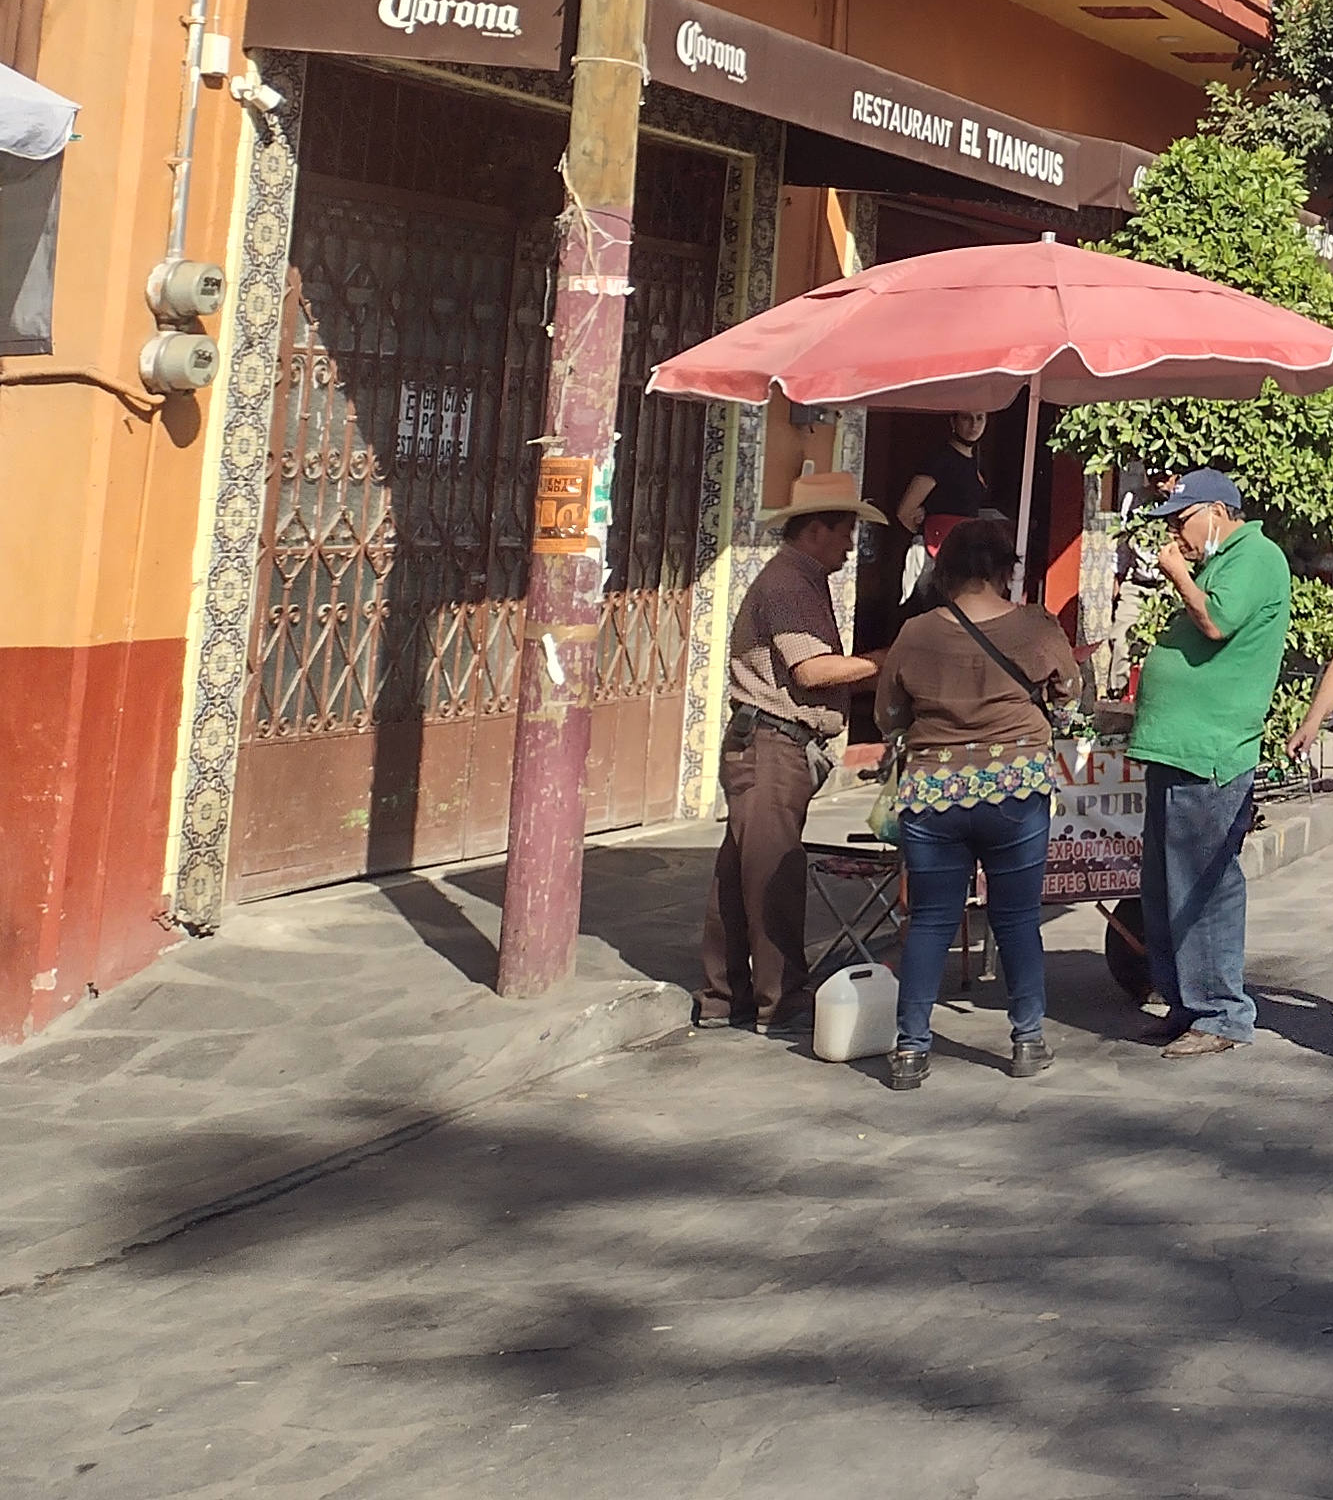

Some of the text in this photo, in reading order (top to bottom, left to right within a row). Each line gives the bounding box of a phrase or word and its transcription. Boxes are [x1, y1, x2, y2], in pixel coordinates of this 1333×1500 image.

[676, 20, 747, 76] Corona
[852, 89, 1064, 186] RESTAURANT EL TIANGUIS
[1056, 748, 1146, 786] AFE
[1076, 791, 1145, 817] PUR
[1088, 868, 1141, 890] VERAC
